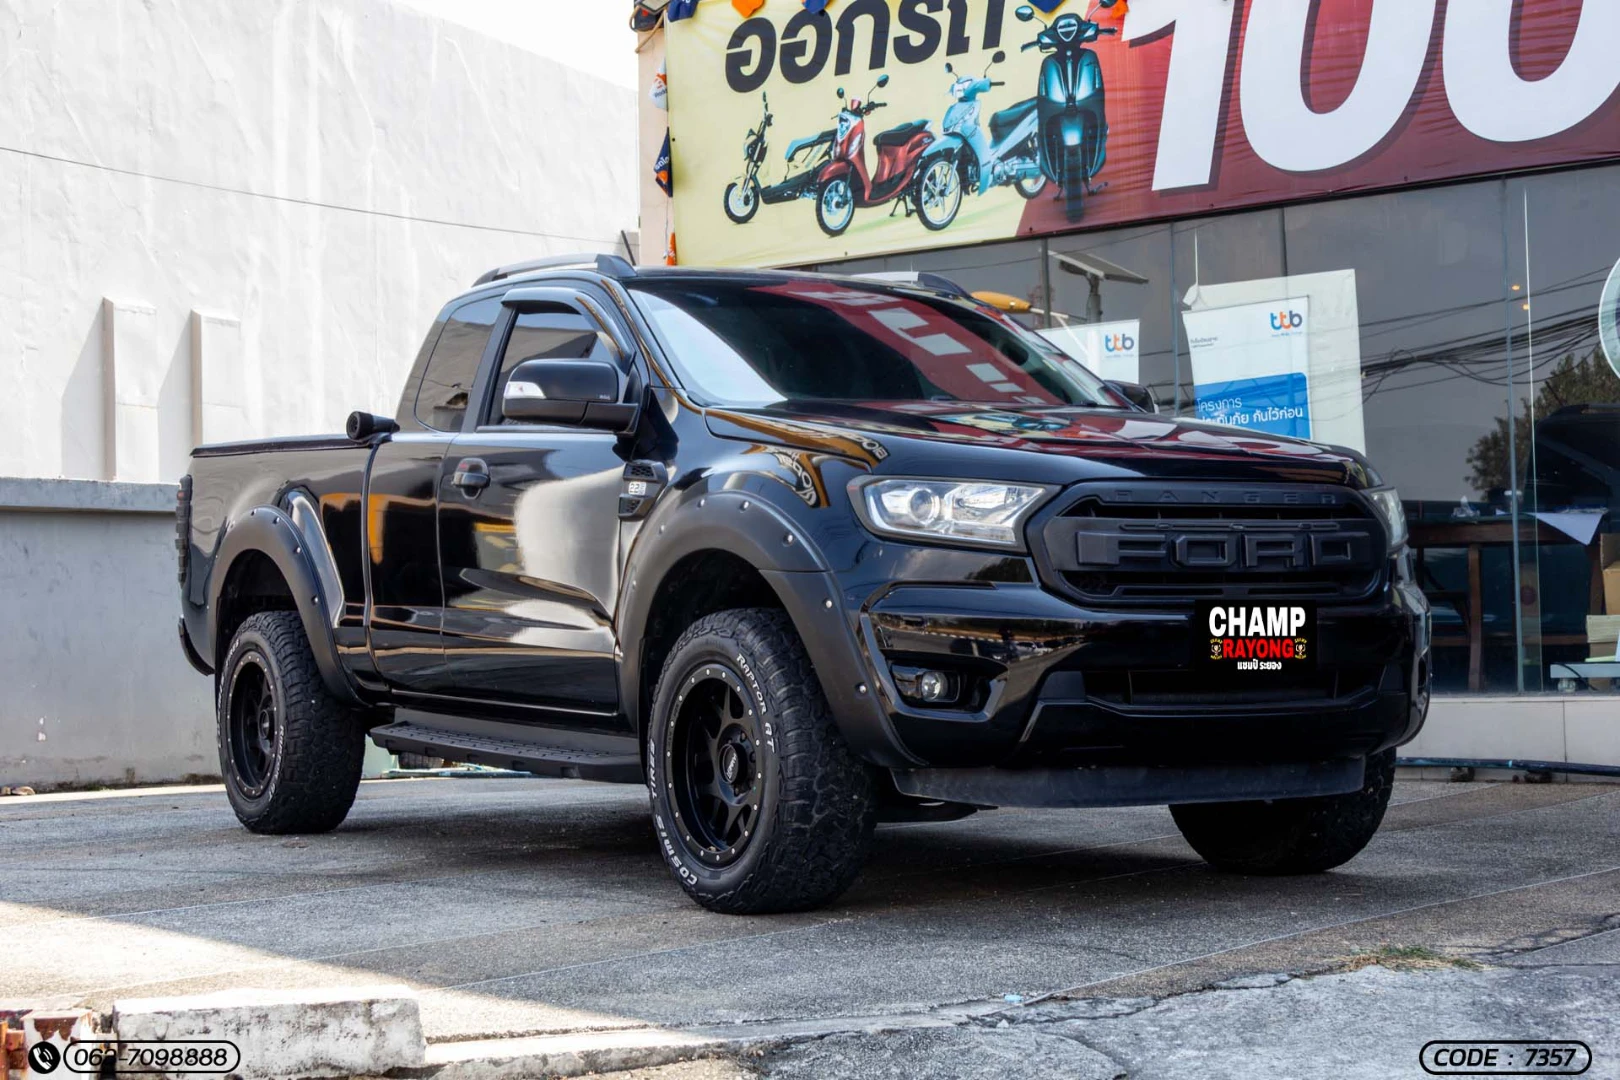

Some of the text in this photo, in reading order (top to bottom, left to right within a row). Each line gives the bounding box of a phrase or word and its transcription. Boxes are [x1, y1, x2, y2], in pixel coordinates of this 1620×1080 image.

[1269, 310, 1302, 331] ttb
[1105, 333, 1134, 352] ttb
[1077, 531, 1370, 567] FORD
[737, 653, 767, 715] RAPTOR
[655, 813, 698, 885] COSMIS
